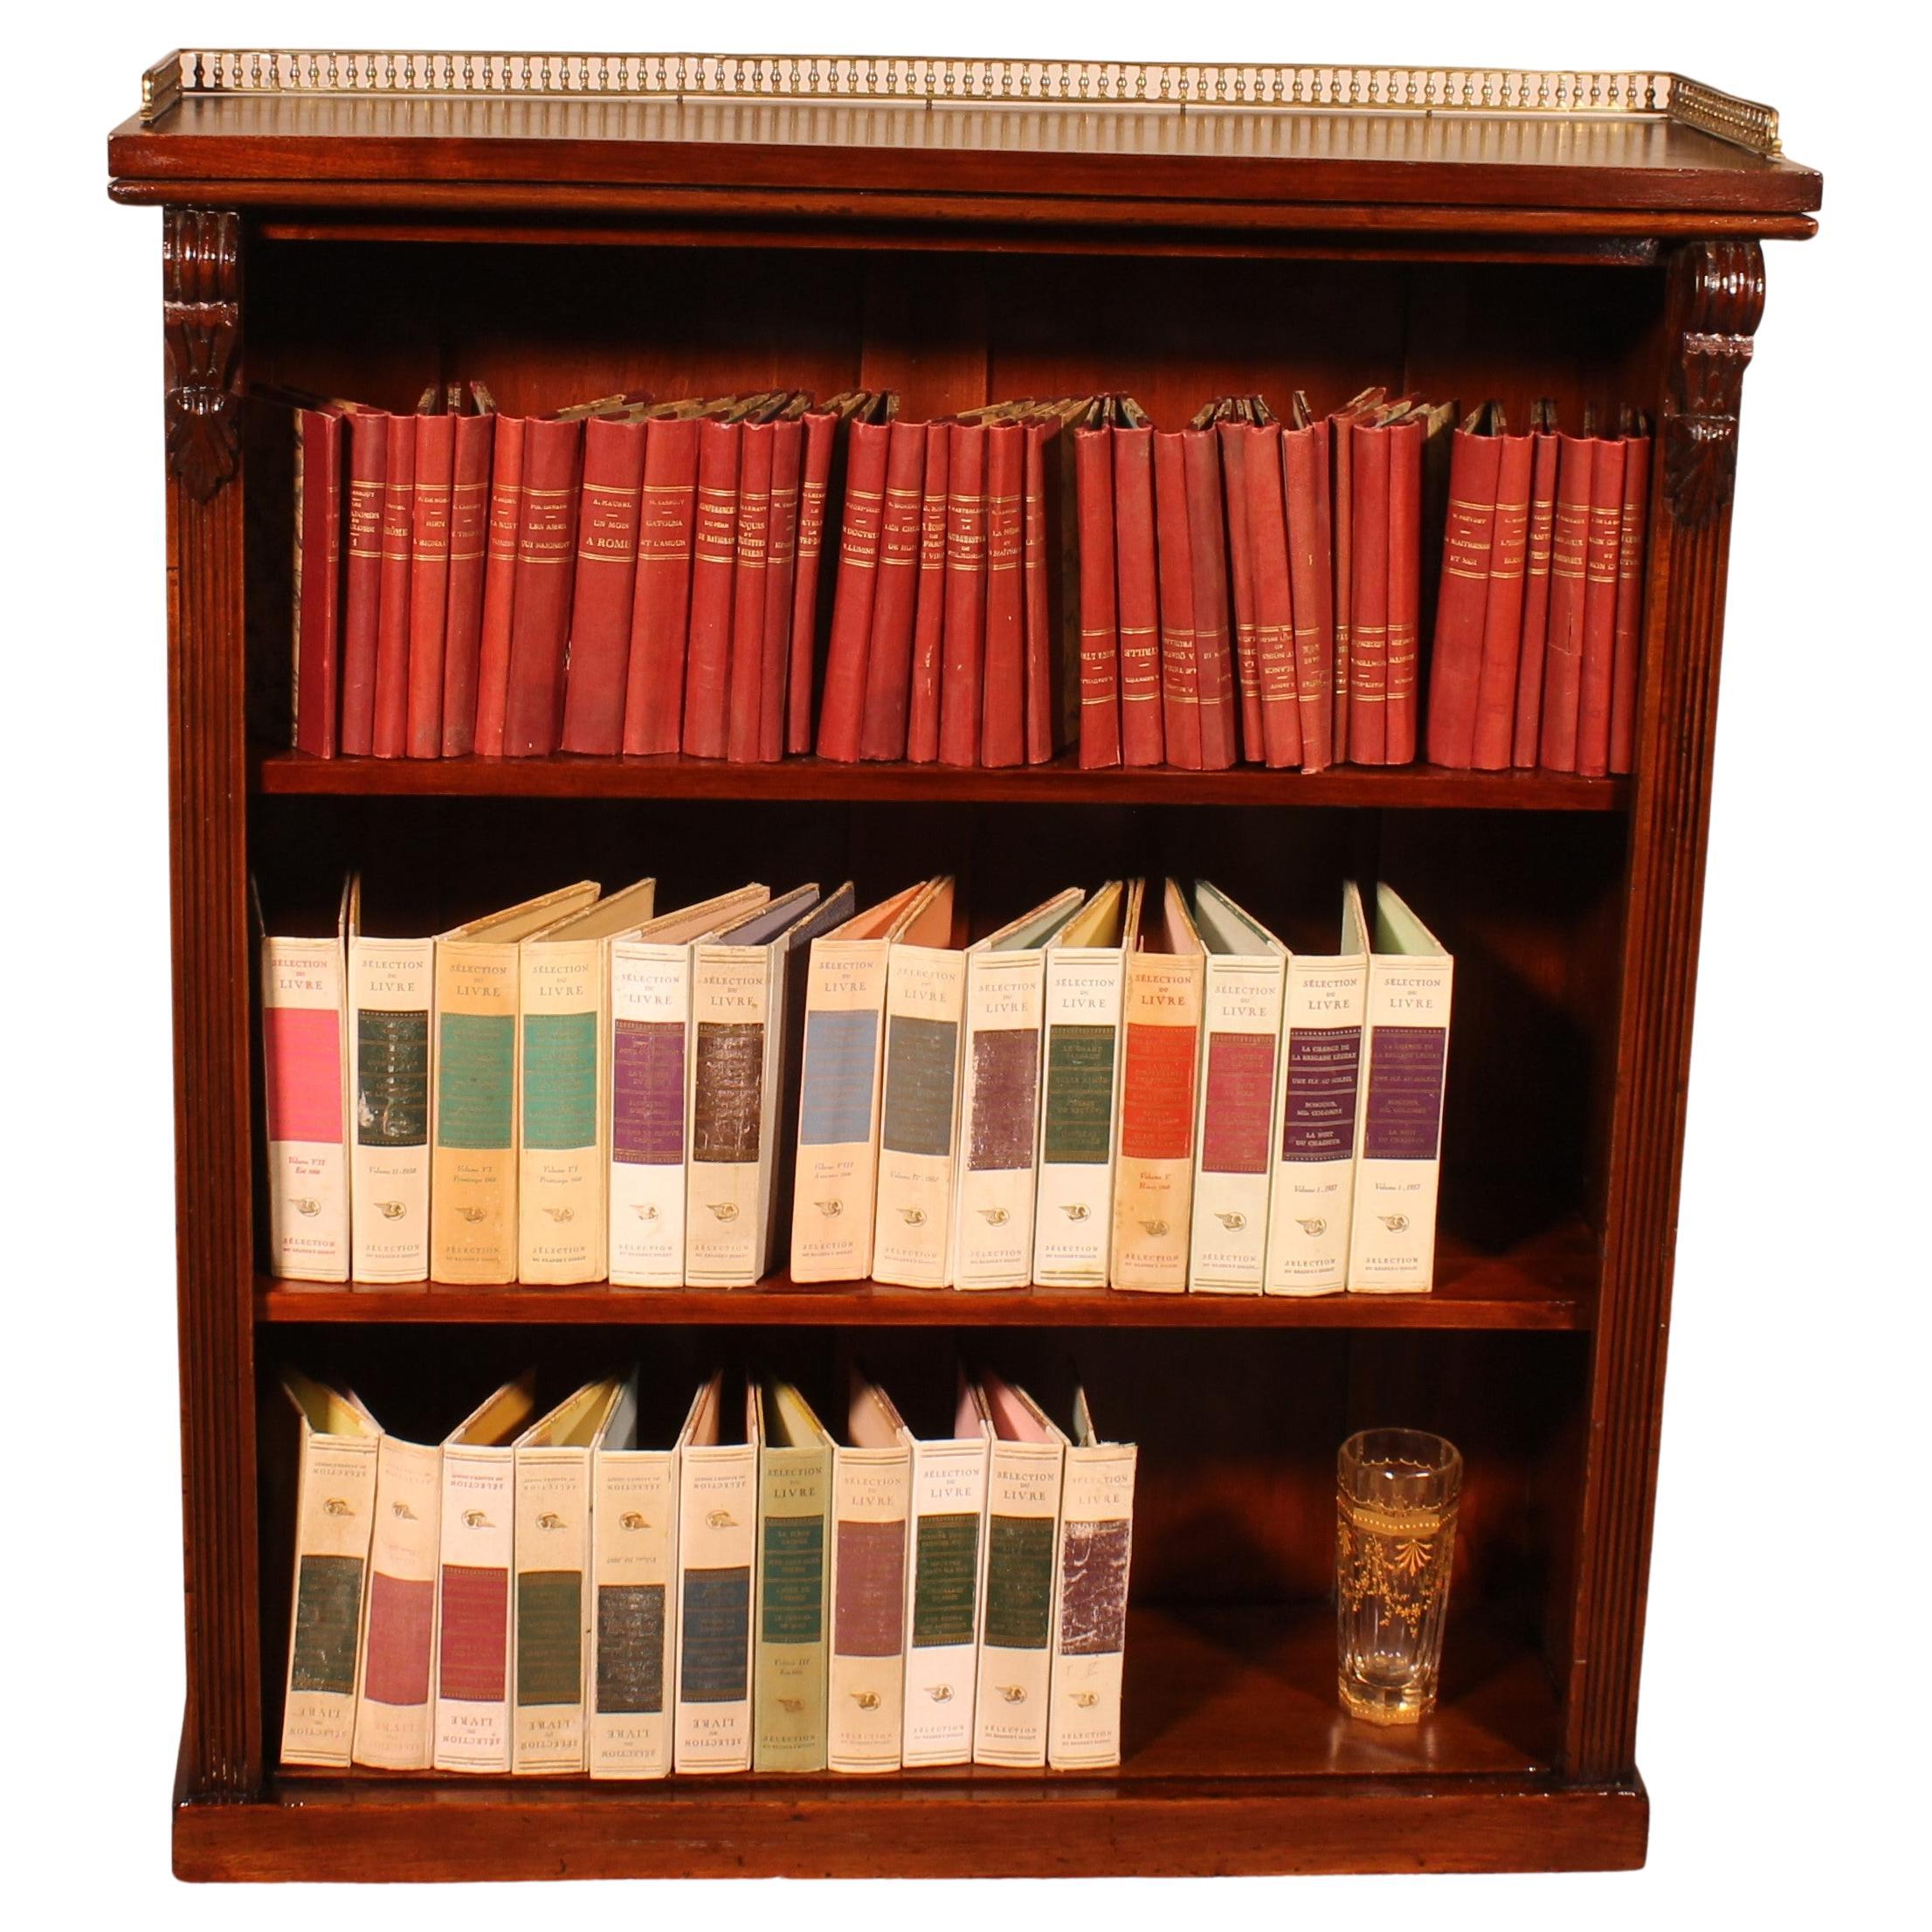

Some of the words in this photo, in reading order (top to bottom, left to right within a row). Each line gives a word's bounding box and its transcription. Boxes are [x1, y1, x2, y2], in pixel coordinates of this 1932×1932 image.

[362, 960, 424, 970] SÉLECTION
[449, 963, 507, 975] SÉLECTION
[532, 963, 590, 975] SÉLECTION
[818, 960, 874, 969] SÉLECTION
[703, 976, 762, 986] SÉLECTION
[1054, 977, 1115, 987] SÉLECTION
[1135, 973, 1192, 983] SÉLECTION
[1302, 977, 1357, 989] SÉLECTION
[1383, 977, 1441, 987] SÉLECTION
[279, 980, 323, 991] LIVRE
[369, 981, 415, 992] LIVRE
[456, 984, 501, 997] LIVRE
[539, 984, 583, 997] LIVRE
[825, 982, 867, 992] LIVRE
[1214, 985, 1276, 996] SÉLECTION
[629, 994, 673, 1005] LIVRE
[904, 990, 947, 1003] LIVRE
[1141, 995, 1185, 1006] LIVRE
[985, 1002, 1029, 1013] LIVRE
[1061, 998, 1107, 1008] LIVRE
[1308, 999, 1350, 1010] LIVRE
[1390, 998, 1433, 1009] LIVRE
[1222, 1006, 1267, 1017] LIVRE
[768, 1466, 823, 1477] SÉLECTION
[922, 1468, 980, 1479] SÉLECTION
[997, 1471, 1055, 1481] SÉLECTION
[774, 1487, 816, 1499] LIVRE
[930, 1487, 972, 1498] LIVRE
[1004, 1490, 1046, 1501] LIVRE
[852, 1496, 894, 1506] LIVRE
[1078, 1494, 1121, 1505] LIVRE
[299, 1708, 342, 1718] LIVRE
[451, 1715, 493, 1727] LIVRE
[528, 1719, 571, 1731] LIVRE
[692, 1718, 735, 1728] LIVRE
[608, 1729, 651, 1739] LIVRE
[442, 1735, 500, 1746] SÉLECTION
[684, 1738, 742, 1748] SÉLECTION
